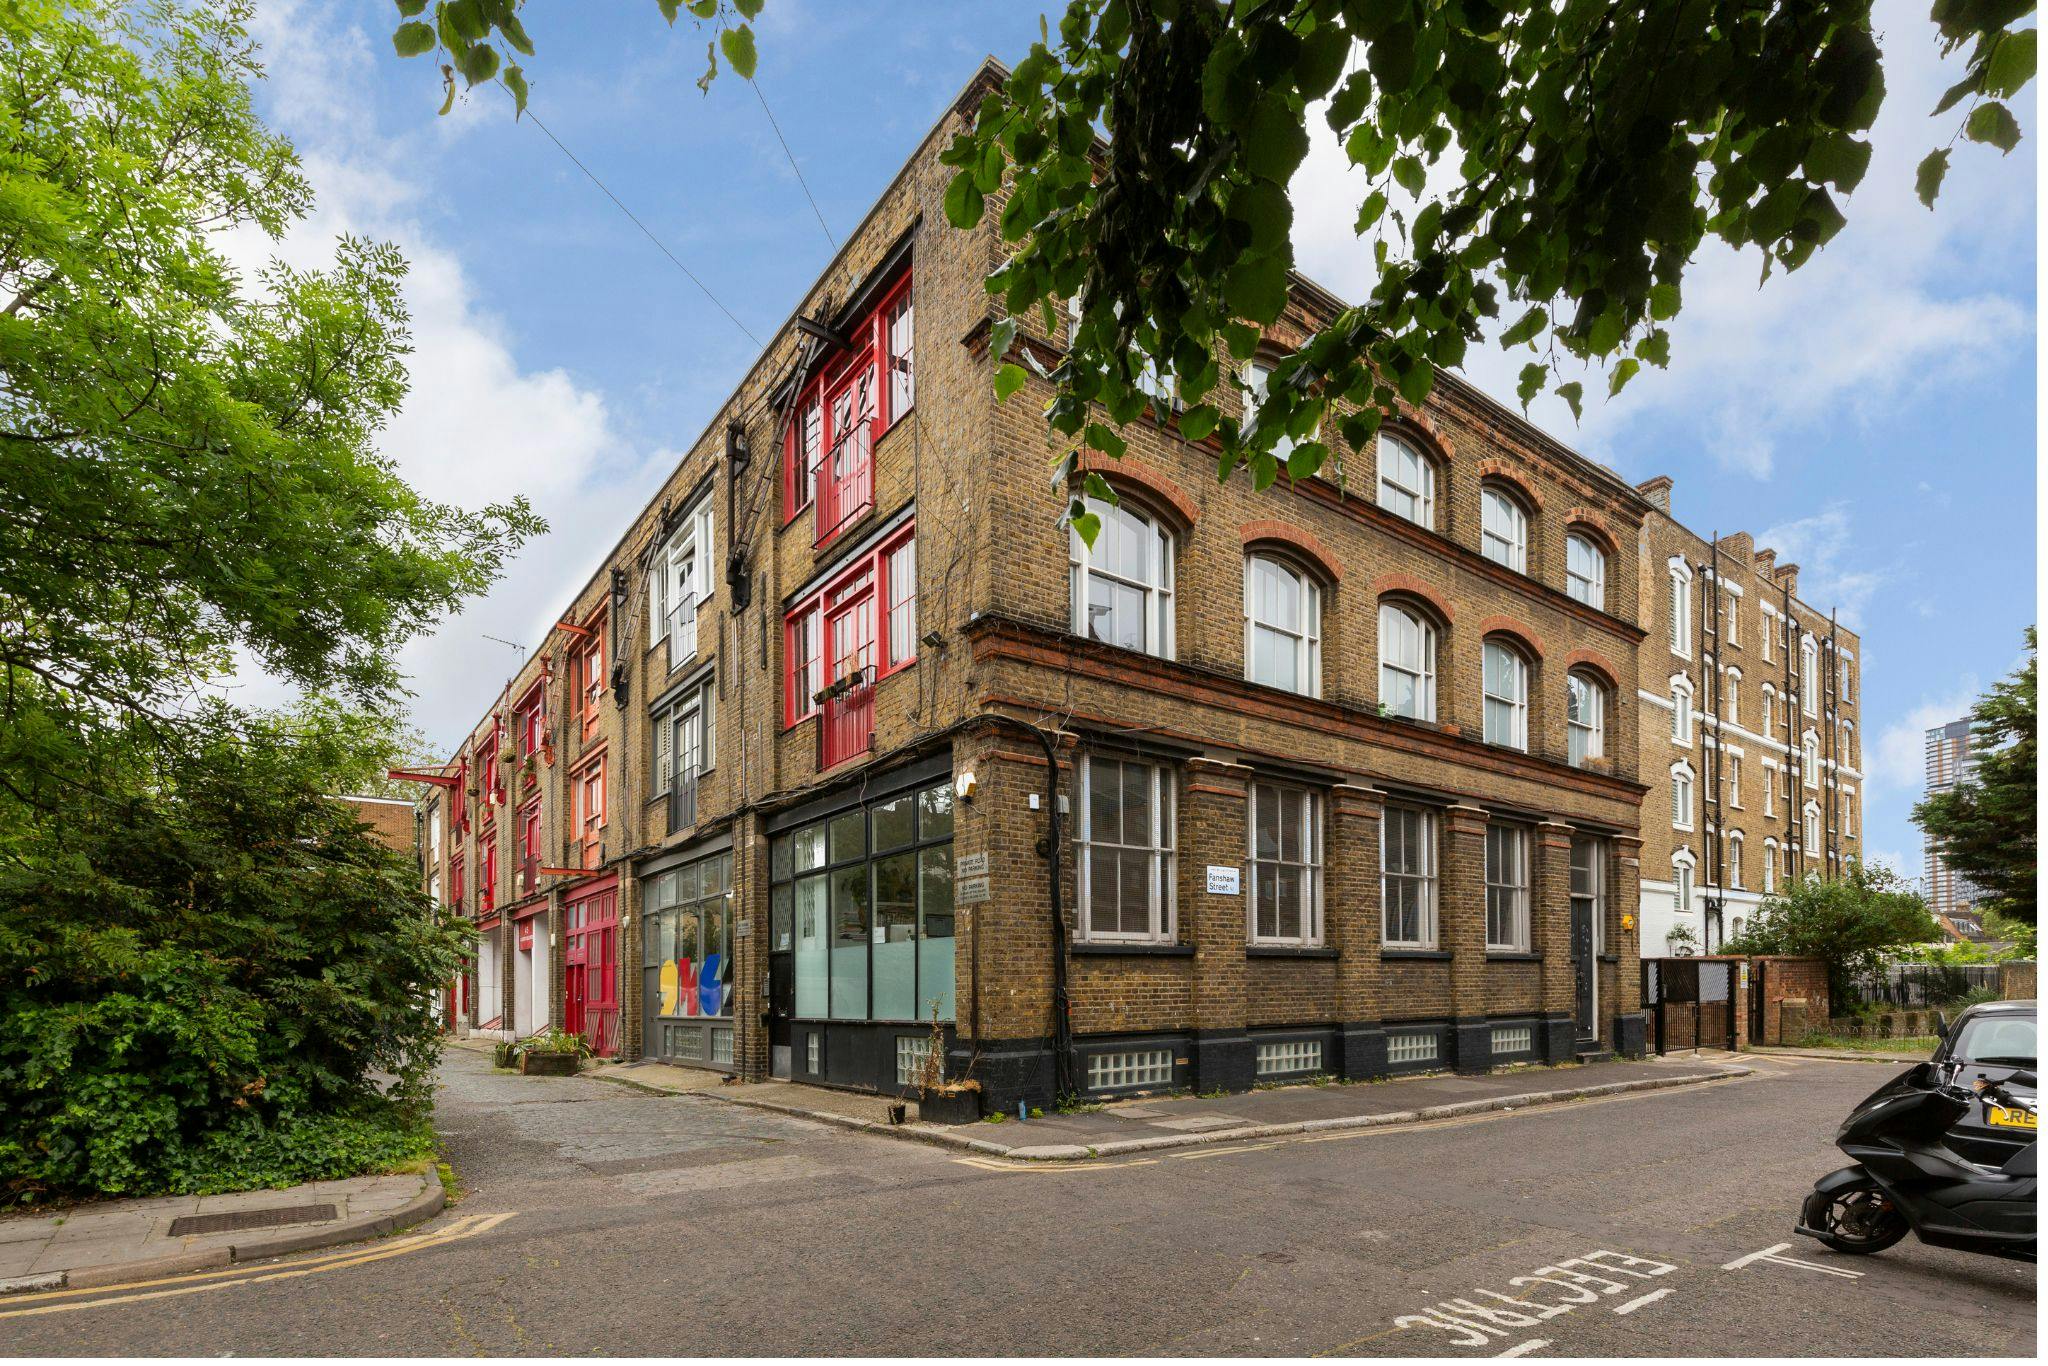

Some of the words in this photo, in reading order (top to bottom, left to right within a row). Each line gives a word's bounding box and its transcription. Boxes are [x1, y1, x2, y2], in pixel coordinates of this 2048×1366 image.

[1209, 873, 1235, 882] Fanshaw
[1209, 882, 1229, 891] Street
[1394, 1250, 1678, 1346] ELECTRIC
